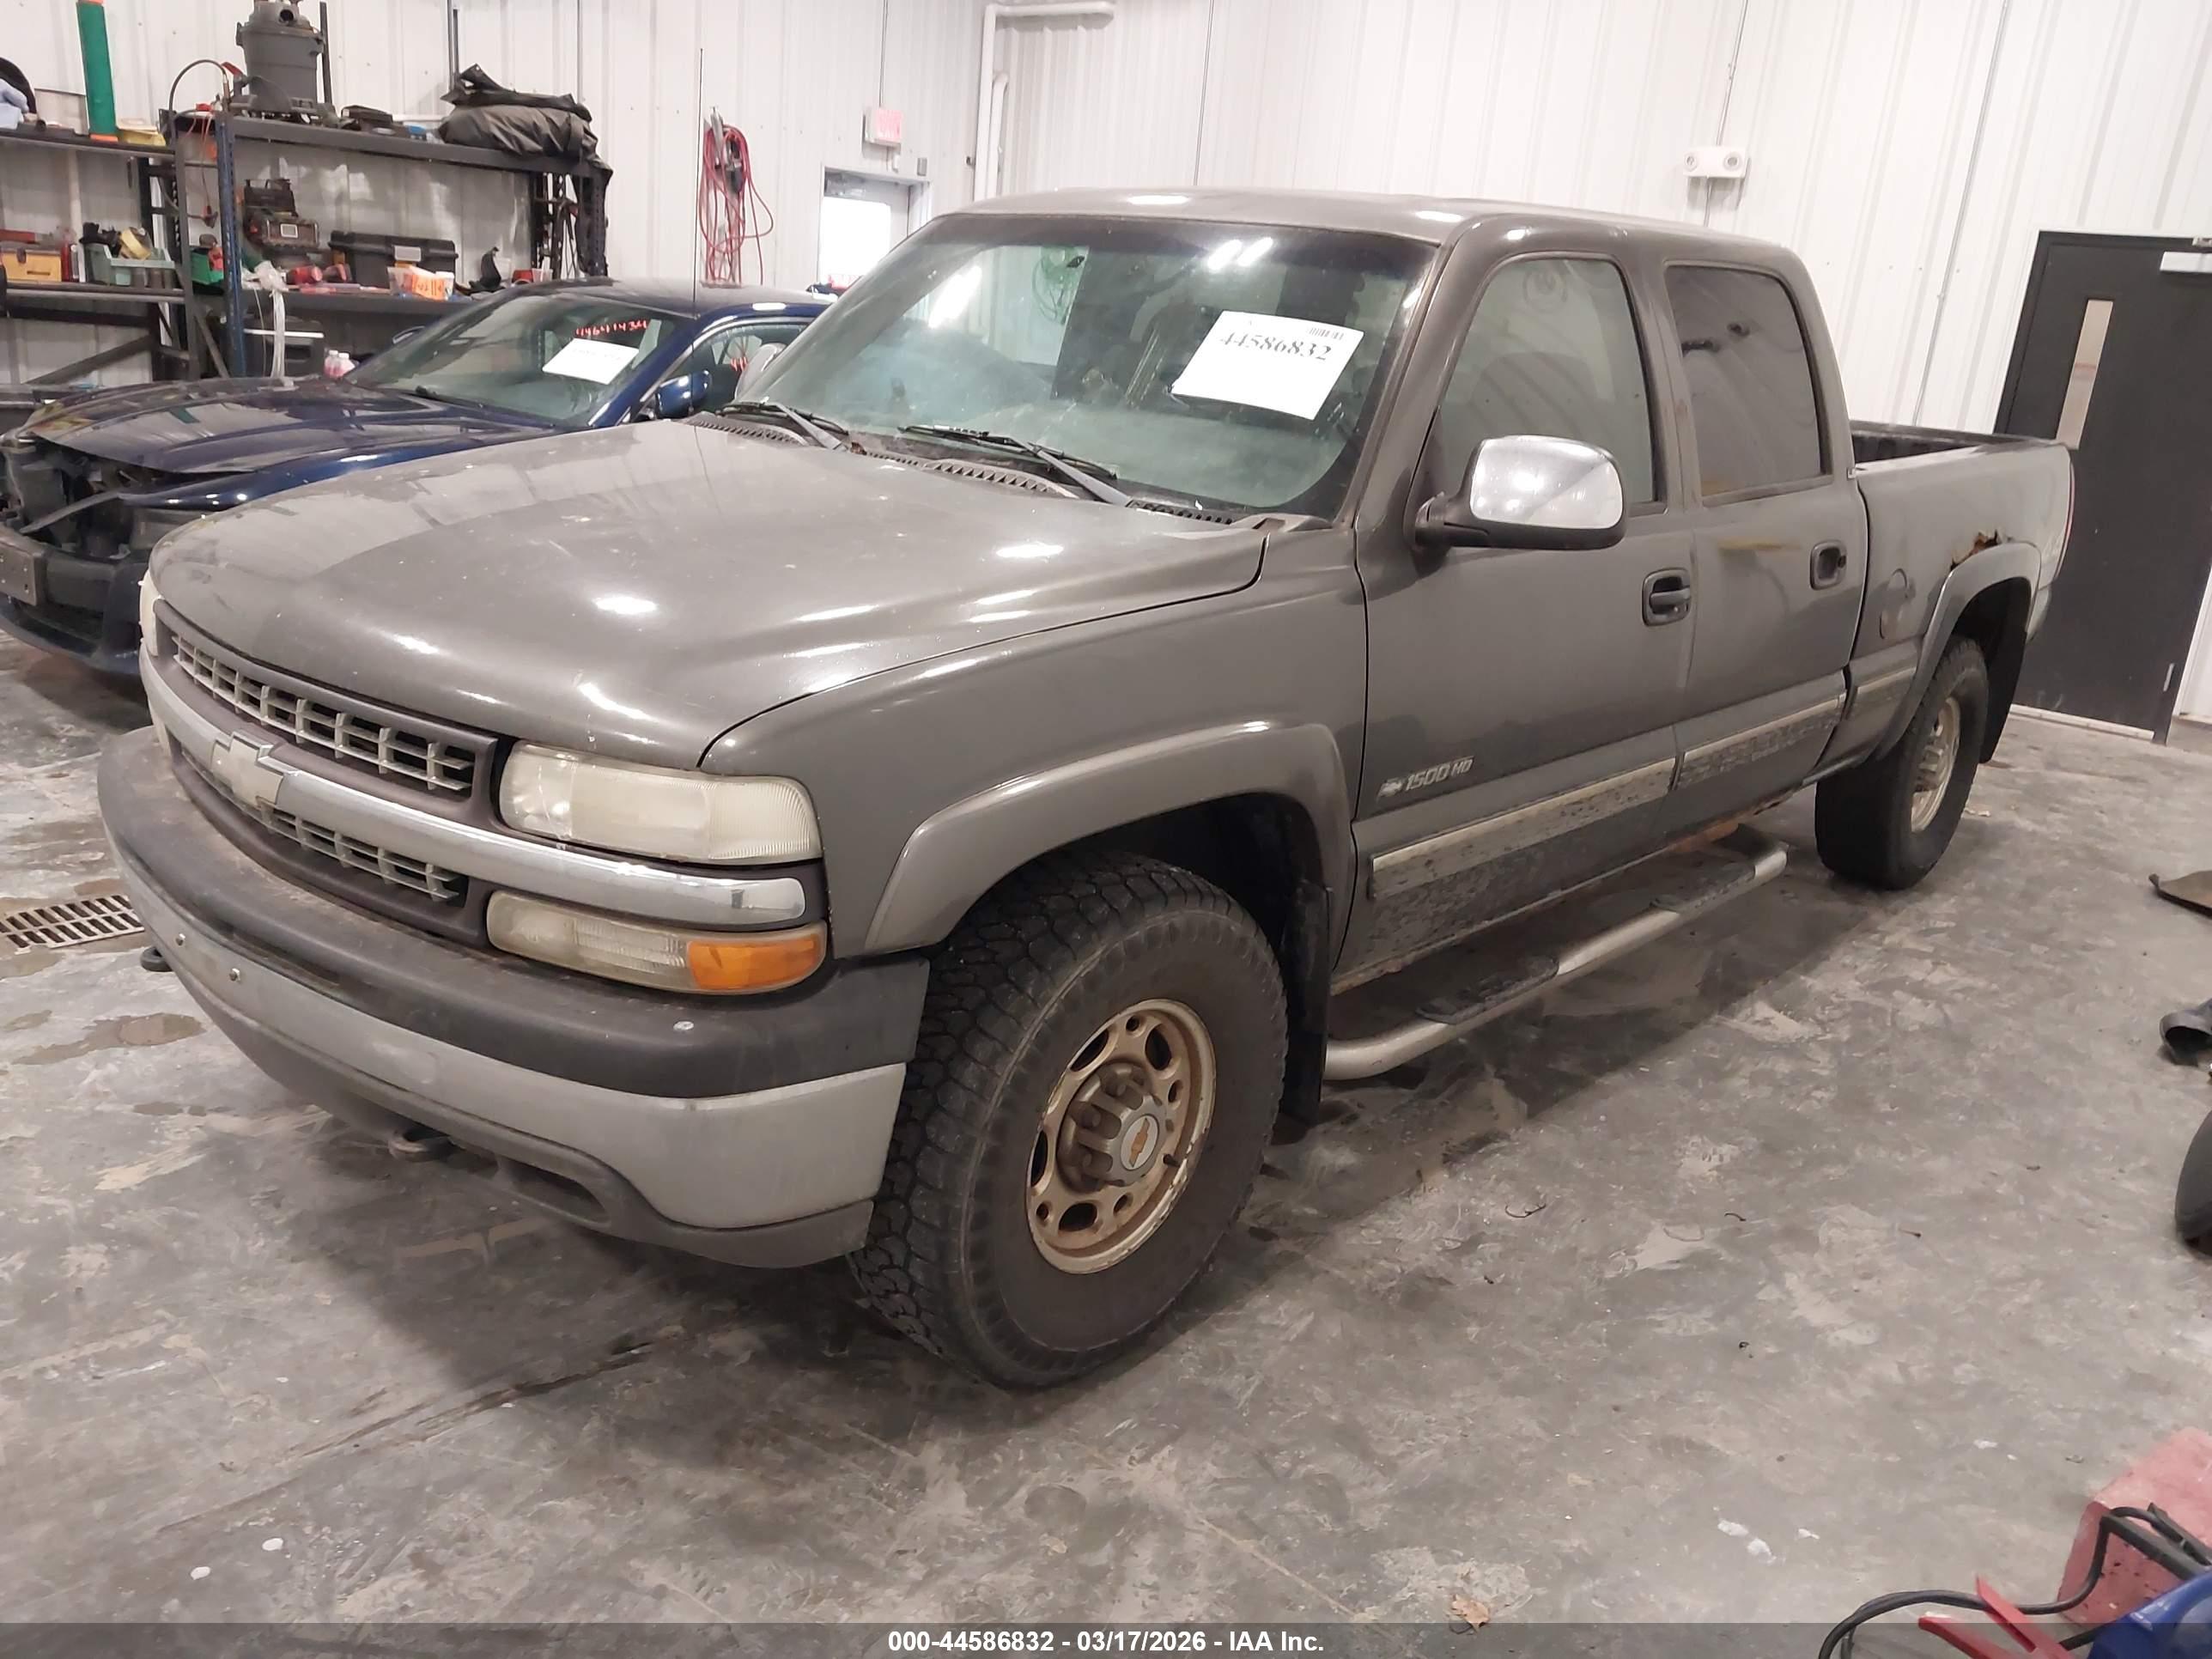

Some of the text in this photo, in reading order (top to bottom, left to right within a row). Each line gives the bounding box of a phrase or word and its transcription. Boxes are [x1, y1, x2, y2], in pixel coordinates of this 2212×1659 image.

[1219, 331, 1333, 362] 44586832
[1405, 757, 1474, 792] 1500 HD
